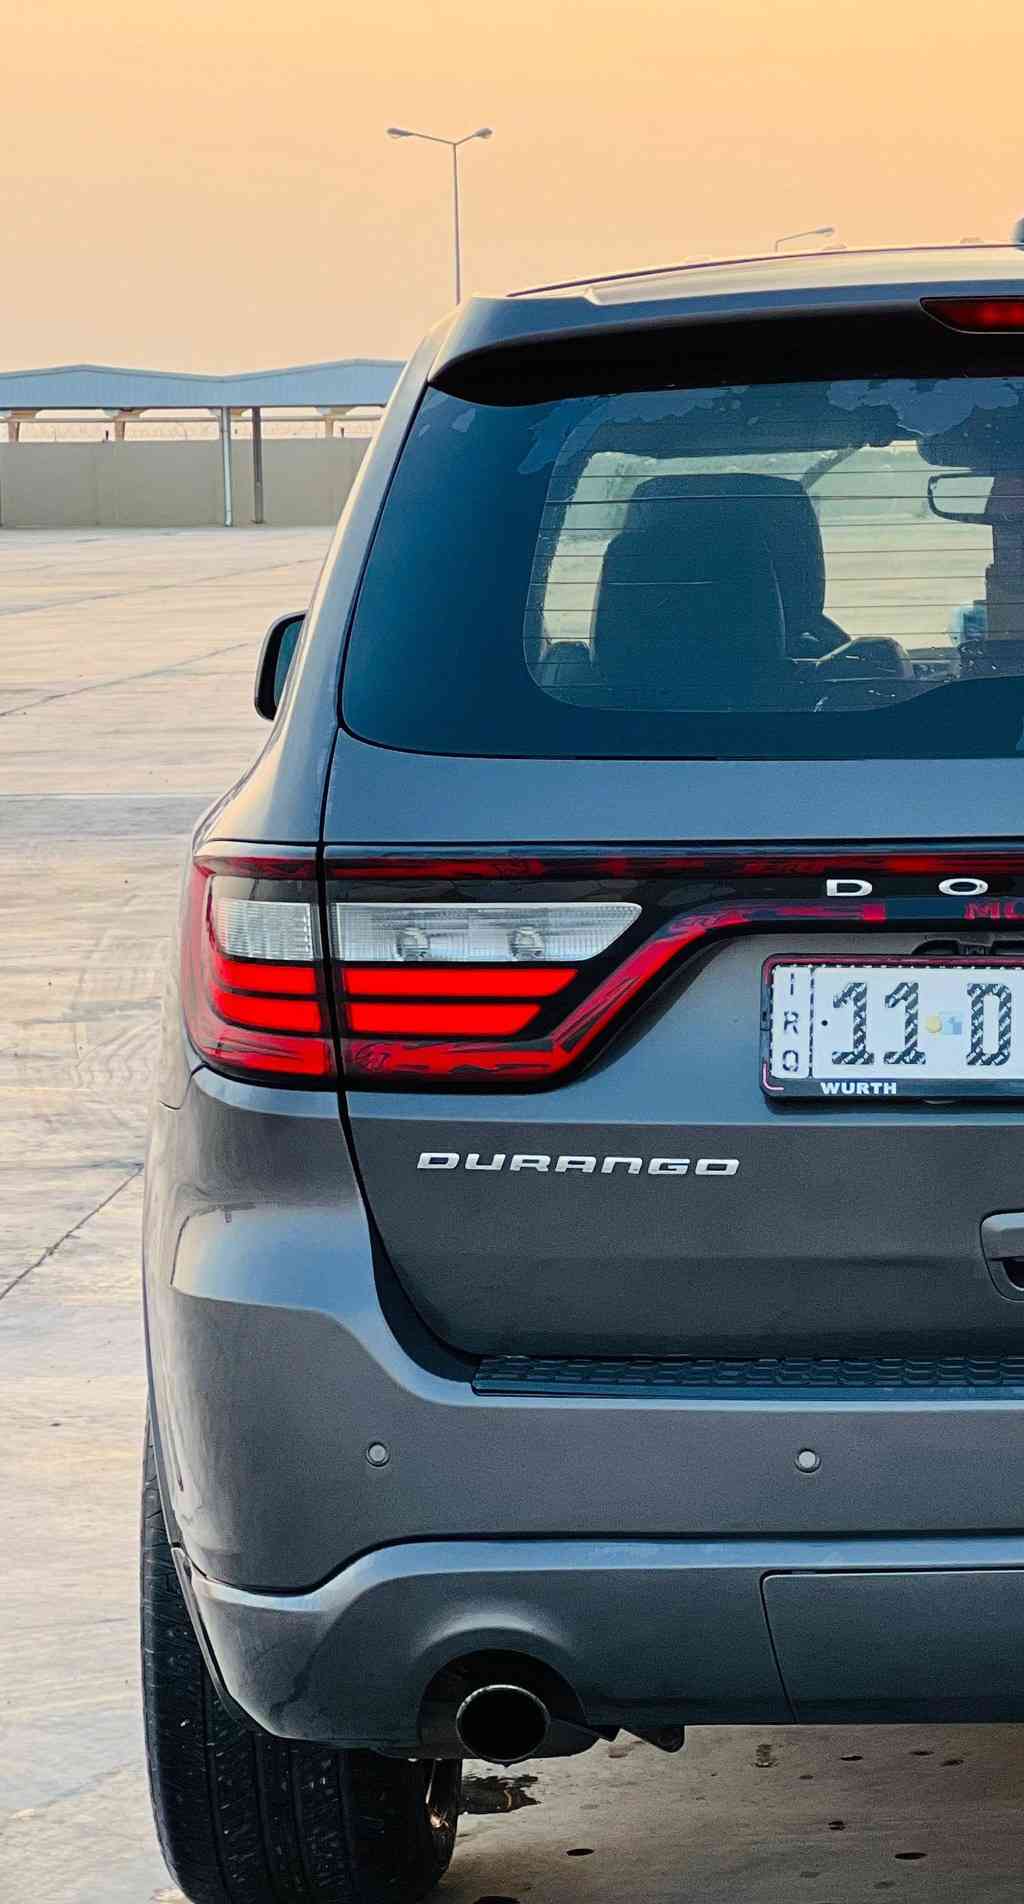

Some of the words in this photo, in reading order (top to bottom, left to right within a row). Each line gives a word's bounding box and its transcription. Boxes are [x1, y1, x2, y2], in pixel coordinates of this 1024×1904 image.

[832, 982, 927, 1065] 11
[966, 983, 1012, 1066] D
[820, 1081, 897, 1095] WURTH
[416, 1152, 740, 1176] DURANGO
